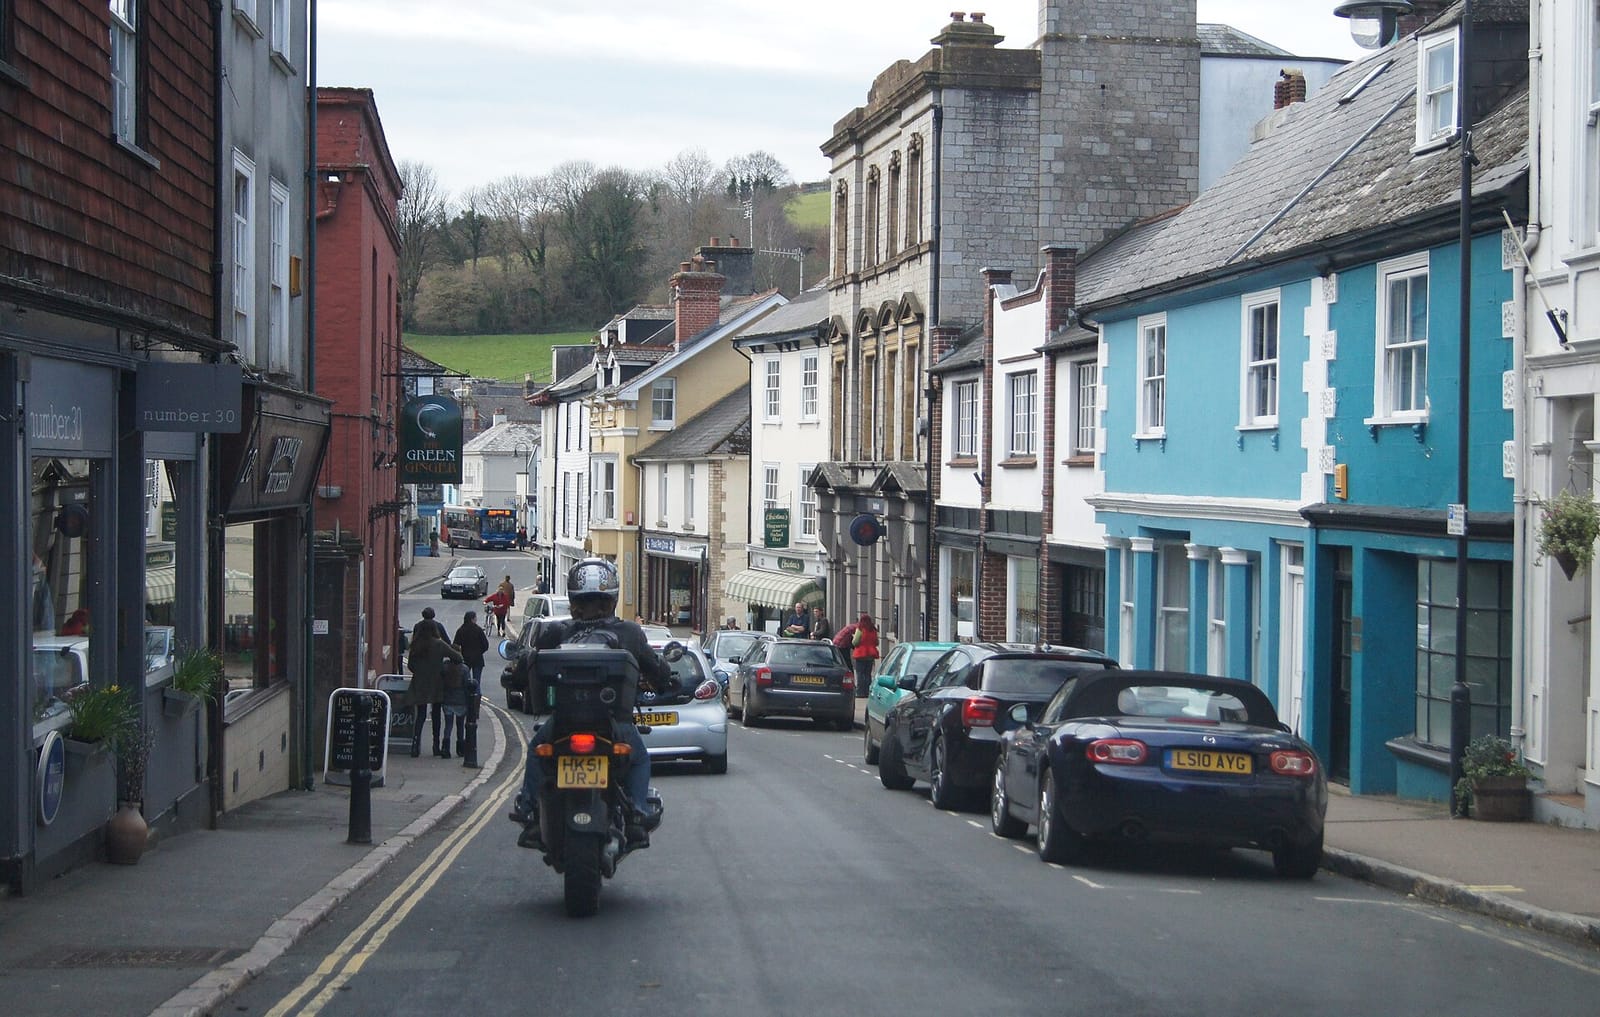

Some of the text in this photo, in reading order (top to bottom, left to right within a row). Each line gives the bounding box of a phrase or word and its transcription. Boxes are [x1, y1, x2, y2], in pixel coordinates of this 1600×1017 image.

[29, 405, 82, 441] number 30
[143, 408, 236, 424] number 30
[406, 449, 456, 462] GREEN
[405, 462, 457, 473] GINGER
[654, 713, 672, 722] DTF
[1176, 751, 1246, 770] LS10 AYG
[562, 757, 602, 785] HK51 URJ
